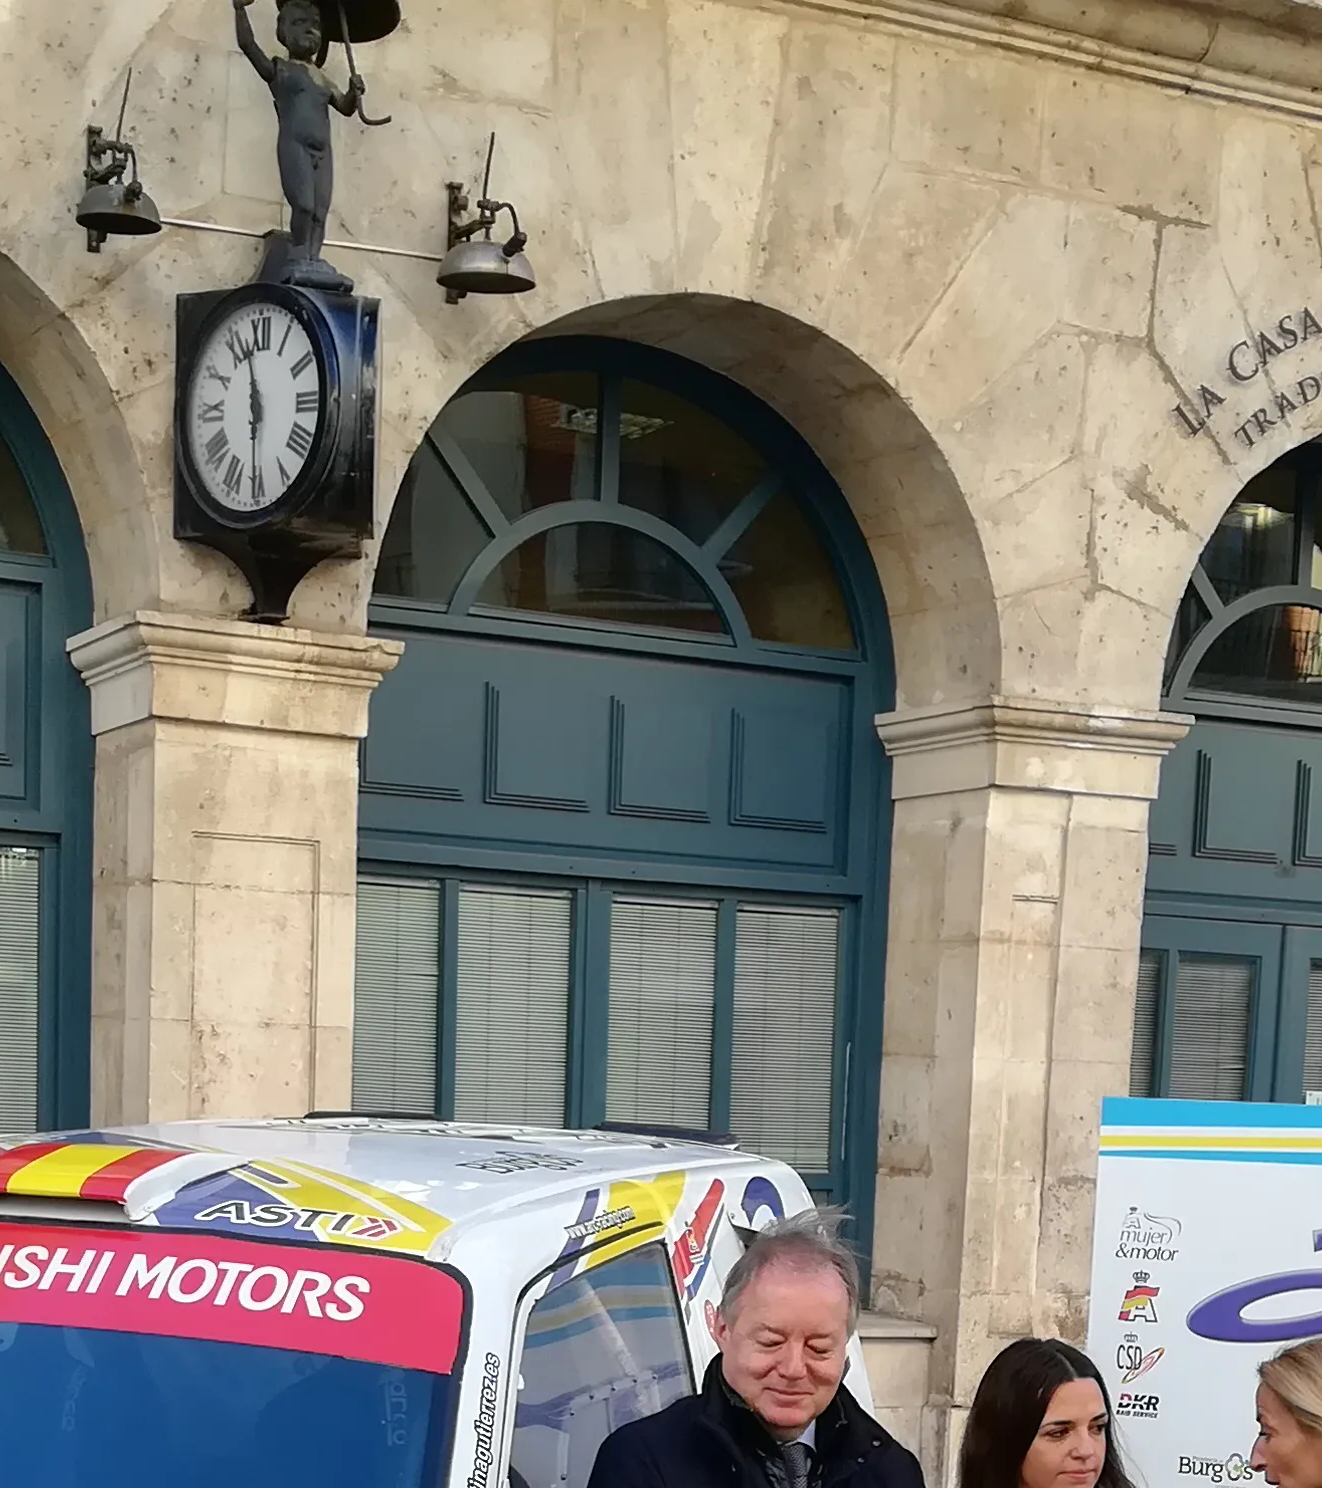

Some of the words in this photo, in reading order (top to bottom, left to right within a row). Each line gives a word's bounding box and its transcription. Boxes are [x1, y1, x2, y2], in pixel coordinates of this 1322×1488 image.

[1172, 383, 1227, 438] LA
[195, 1200, 357, 1239] ASTI
[1119, 1227, 1168, 1245] mujer
[1115, 1244, 1179, 1262] &motor
[116, 1254, 371, 1323] MOTORS
[1117, 1345, 1142, 1370] CSD
[1118, 1393, 1160, 1412] DKR
